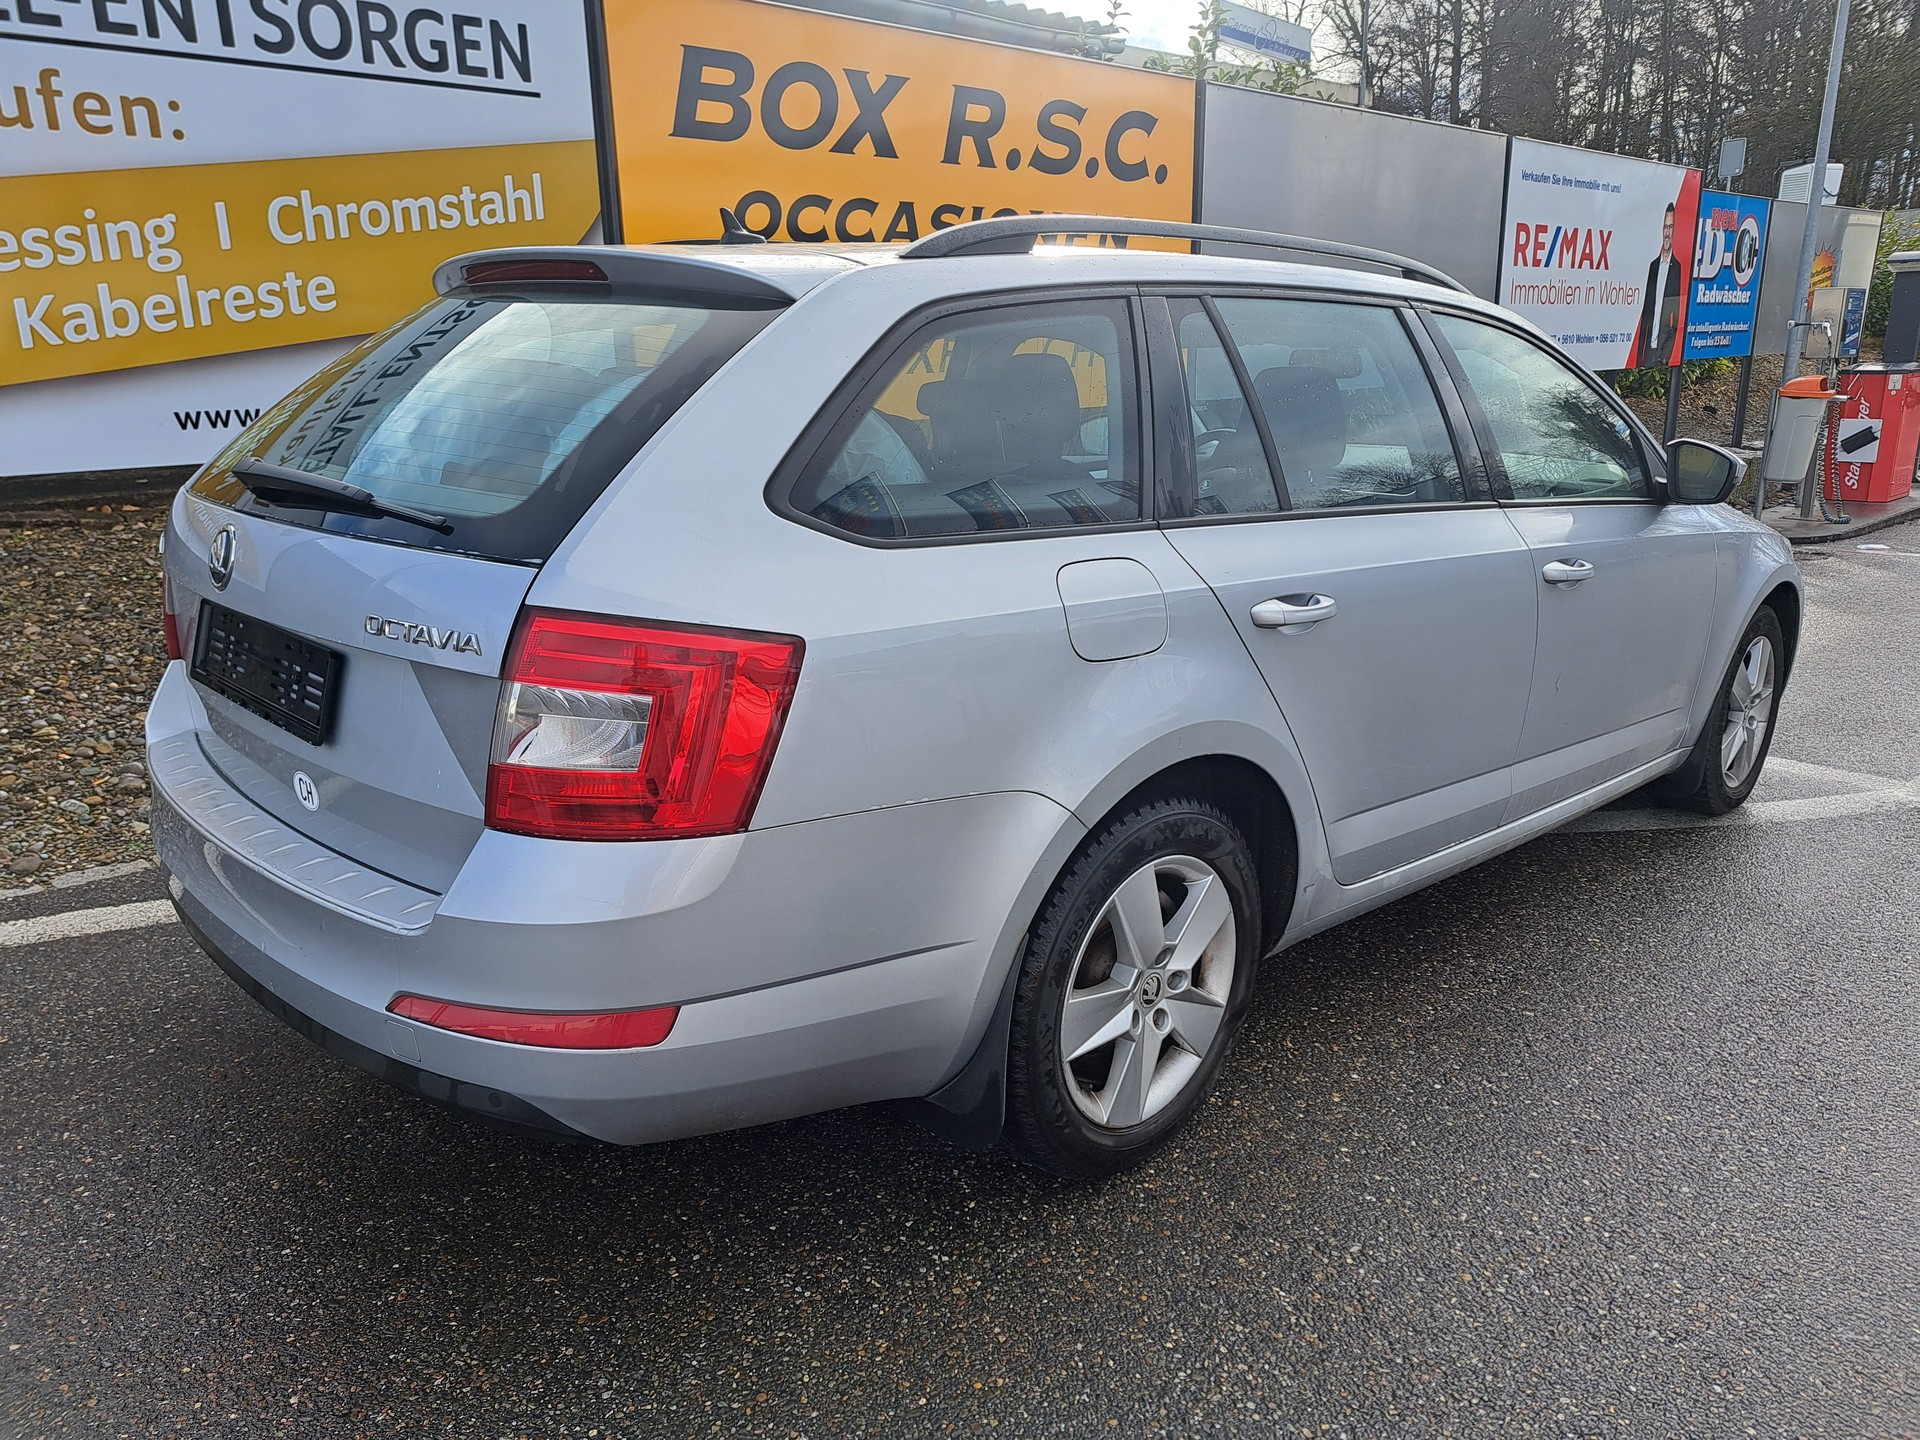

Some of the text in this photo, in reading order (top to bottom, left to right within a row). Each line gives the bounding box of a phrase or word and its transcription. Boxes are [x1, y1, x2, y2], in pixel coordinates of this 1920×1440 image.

[668, 44, 1169, 185] BOX R.S.C.
[1521, 169, 1622, 194] Verkaufen Sie Ihre Immobilie mit uns!
[267, 172, 546, 244] Chromstahl
[1711, 207, 1739, 231] neu
[1513, 222, 1613, 271] RE/MAX
[1510, 277, 1640, 306] Immobilien in Wohlen
[1696, 283, 1752, 304] Radwäscher
[14, 271, 338, 349] Kabelreste
[1561, 334, 1574, 344] 5610
[1575, 333, 1595, 344] Wohlen
[364, 614, 483, 656] OCTAVIA
[298, 777, 313, 802] CH
